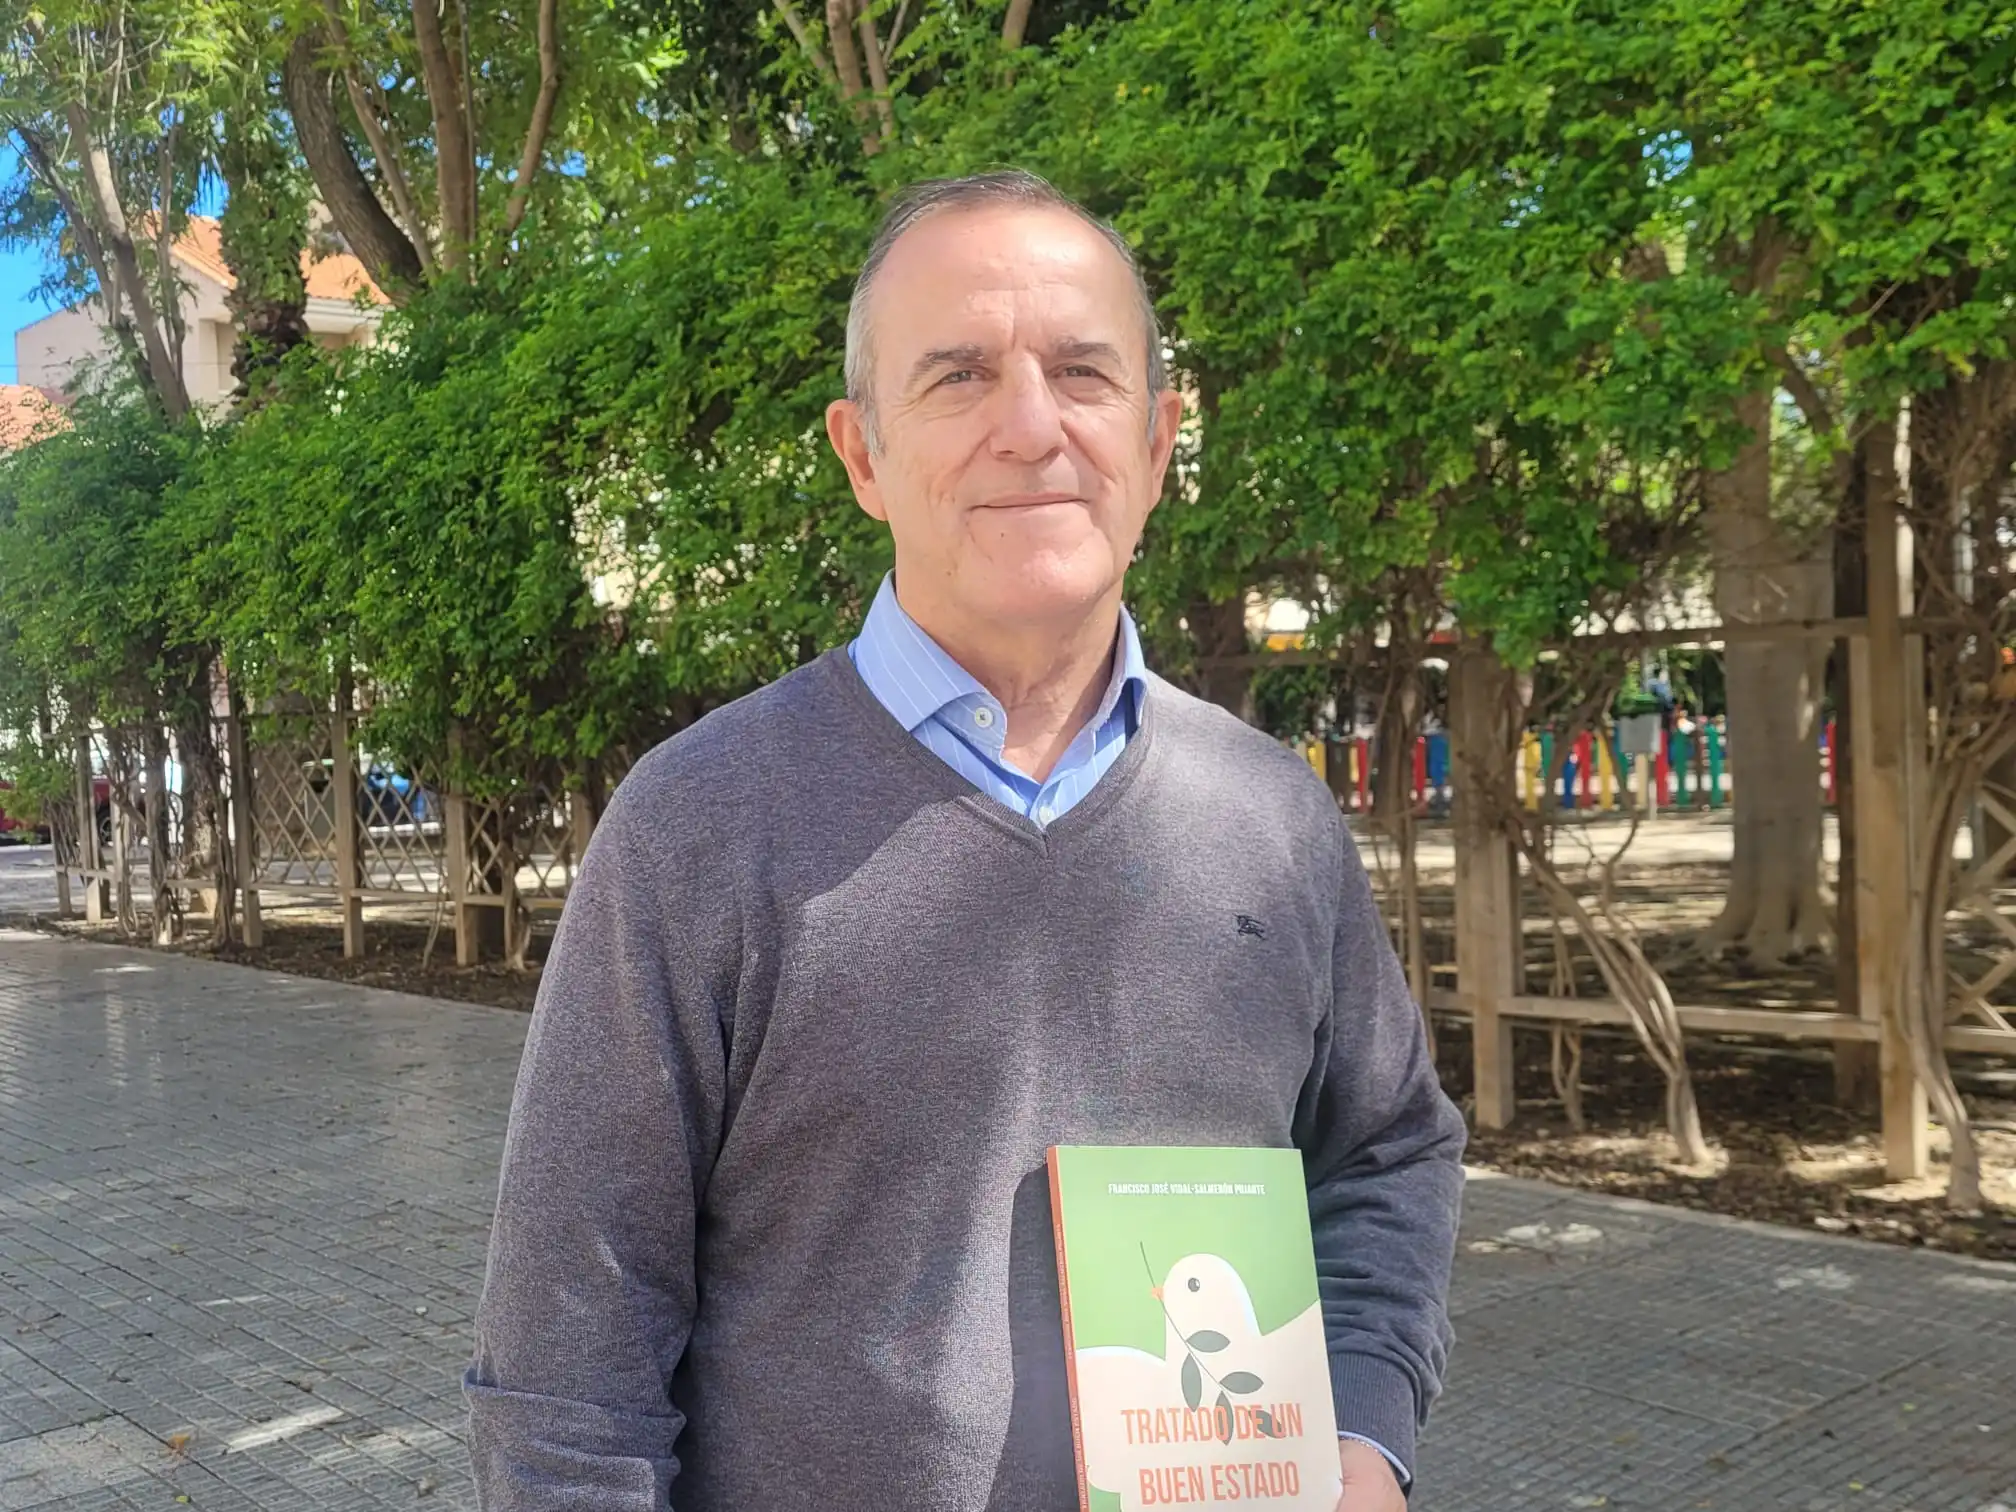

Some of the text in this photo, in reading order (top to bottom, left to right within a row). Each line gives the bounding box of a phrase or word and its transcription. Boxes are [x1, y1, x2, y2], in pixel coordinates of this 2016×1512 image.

[1107, 1183, 1150, 1195] FRANCISCO
[1151, 1181, 1169, 1195] JOSÉ
[1169, 1182, 1234, 1195] VIDAL-SALMERÓN
[1120, 1403, 1304, 1445] TRATADO DE UN
[1138, 1461, 1301, 1506] BUEN ESTADO
